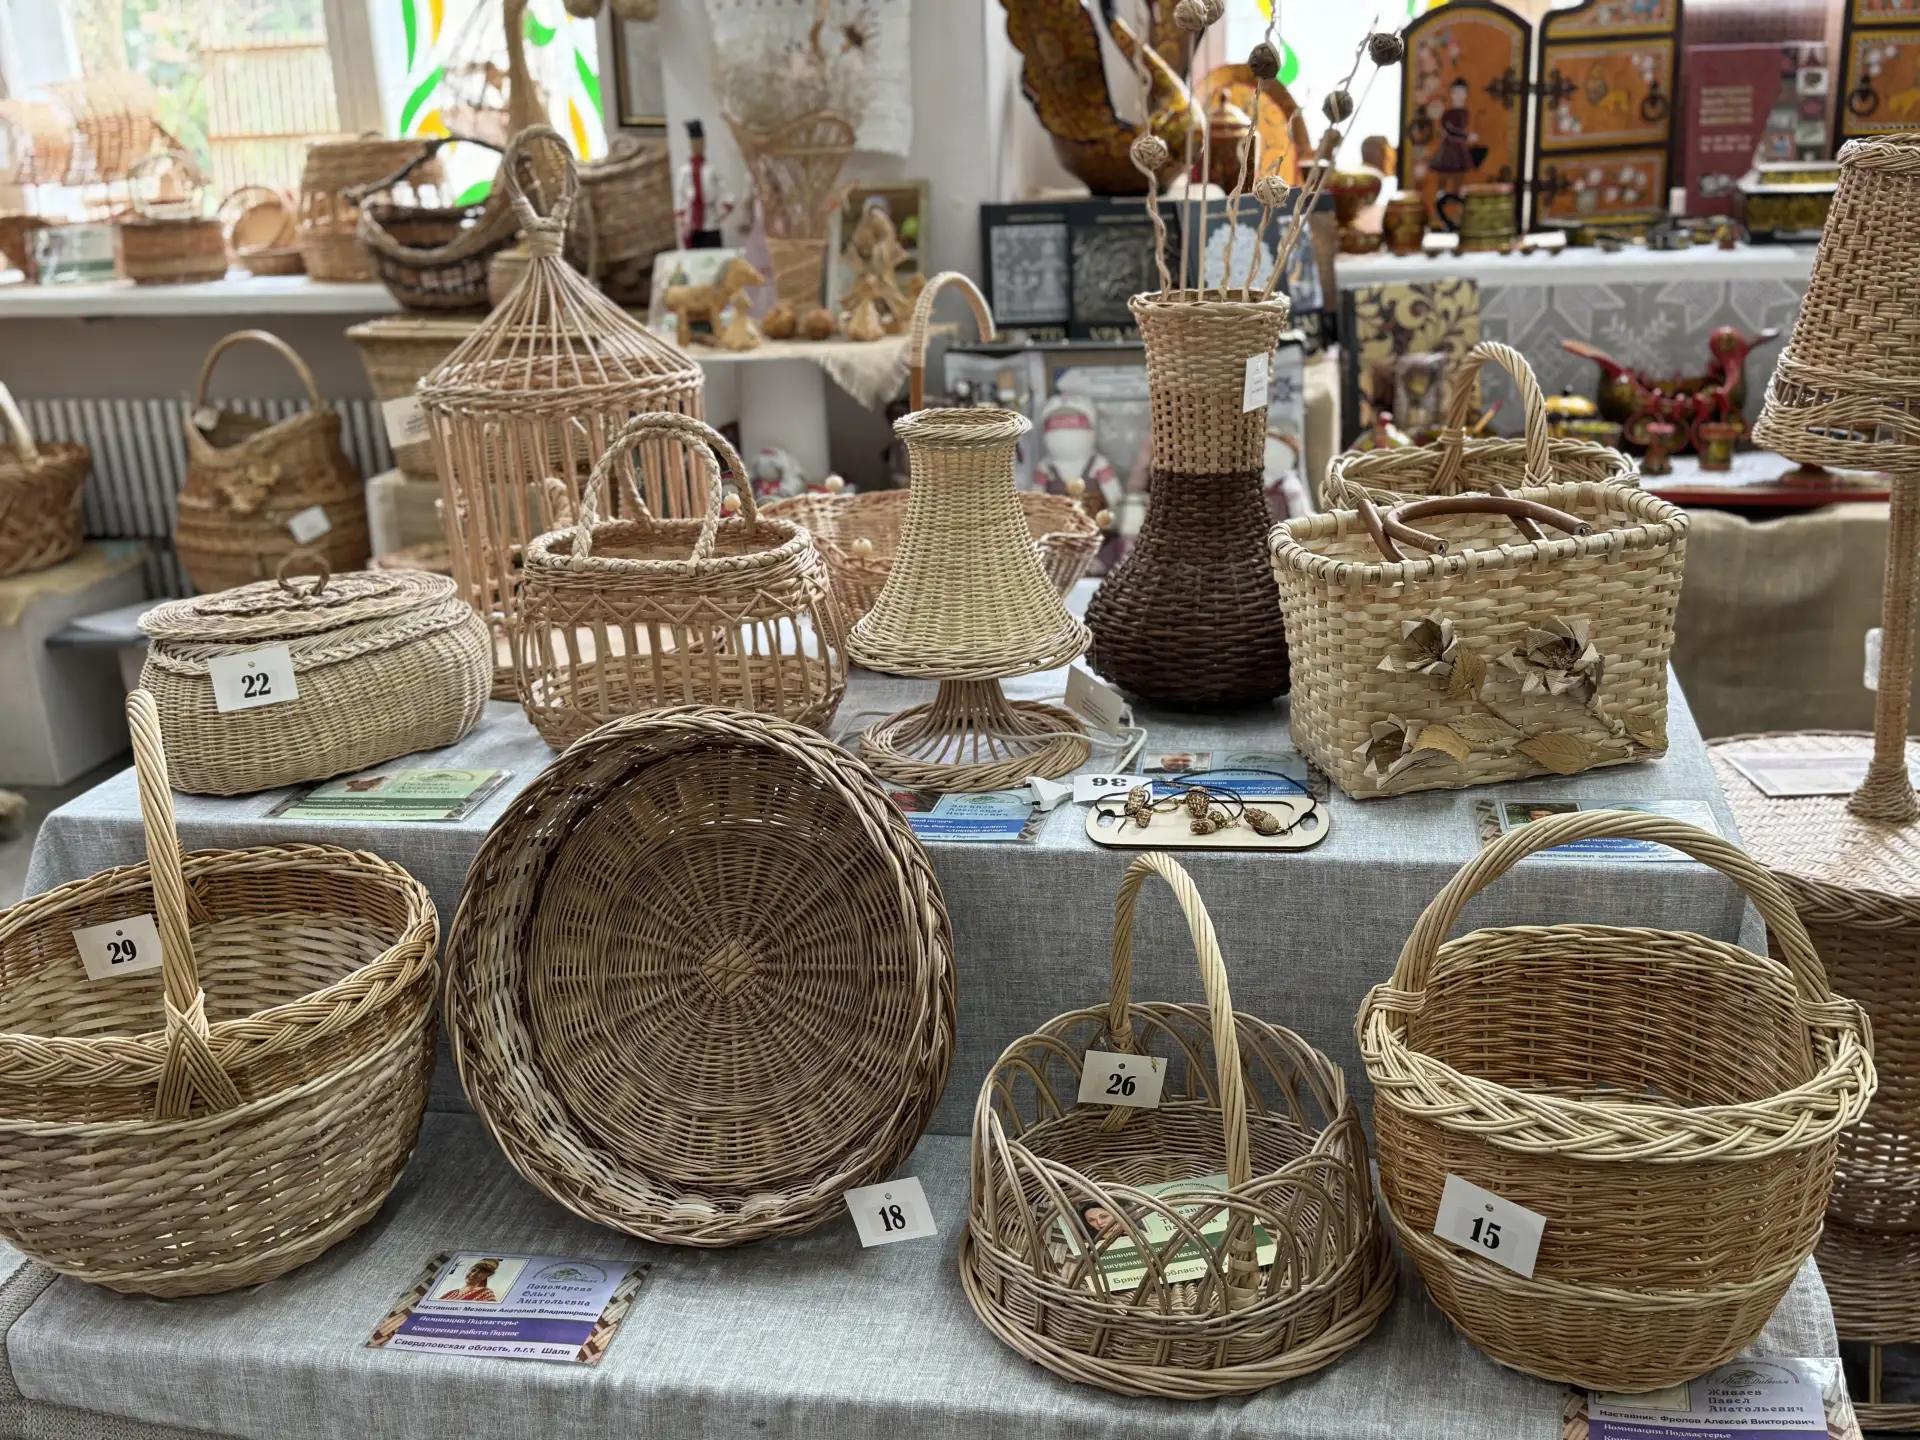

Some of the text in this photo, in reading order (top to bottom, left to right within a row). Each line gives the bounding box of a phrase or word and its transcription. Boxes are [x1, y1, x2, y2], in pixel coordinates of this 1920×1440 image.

[241, 672, 271, 698] 22
[107, 939, 137, 964] 29
[1106, 1073, 1137, 1096] 26
[879, 1204, 906, 1231] 18
[1470, 1217, 1502, 1249] 15
[516, 1297, 591, 1307] Анатольевна
[394, 1338, 466, 1350] Свердловская
[467, 1344, 511, 1353] область,
[541, 1347, 571, 1356] Шаля
[1707, 1388, 1763, 1396] Живаев
[1708, 1405, 1805, 1413] Анатольевич
[1660, 1415, 1702, 1424] Фролов
[1704, 1417, 1748, 1425] Алексей
[1750, 1418, 1815, 1426] Викторович
[1665, 1429, 1732, 1439] Подмастерье
